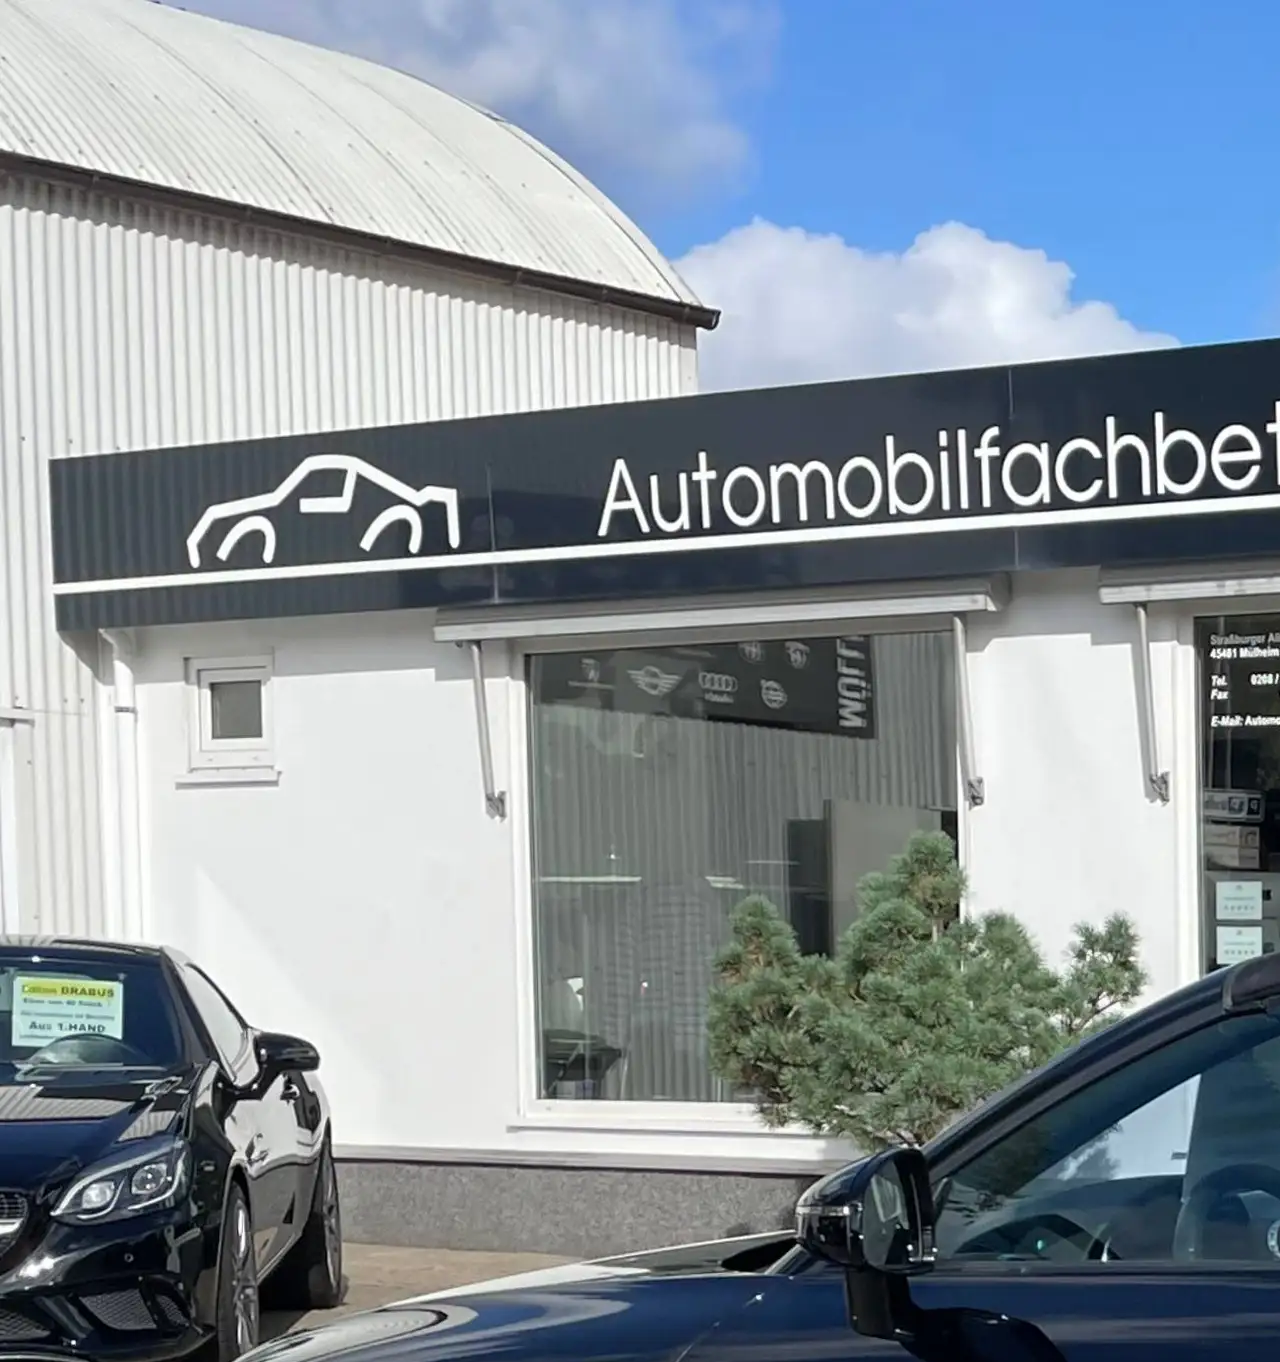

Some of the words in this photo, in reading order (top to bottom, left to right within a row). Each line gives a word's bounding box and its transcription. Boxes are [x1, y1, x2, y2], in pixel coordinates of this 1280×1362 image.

[1239, 646, 1280, 658] Mülheim
[1211, 675, 1228, 686] Tel.
[1211, 688, 1229, 700] Fax
[1211, 715, 1244, 727] E-Mail:
